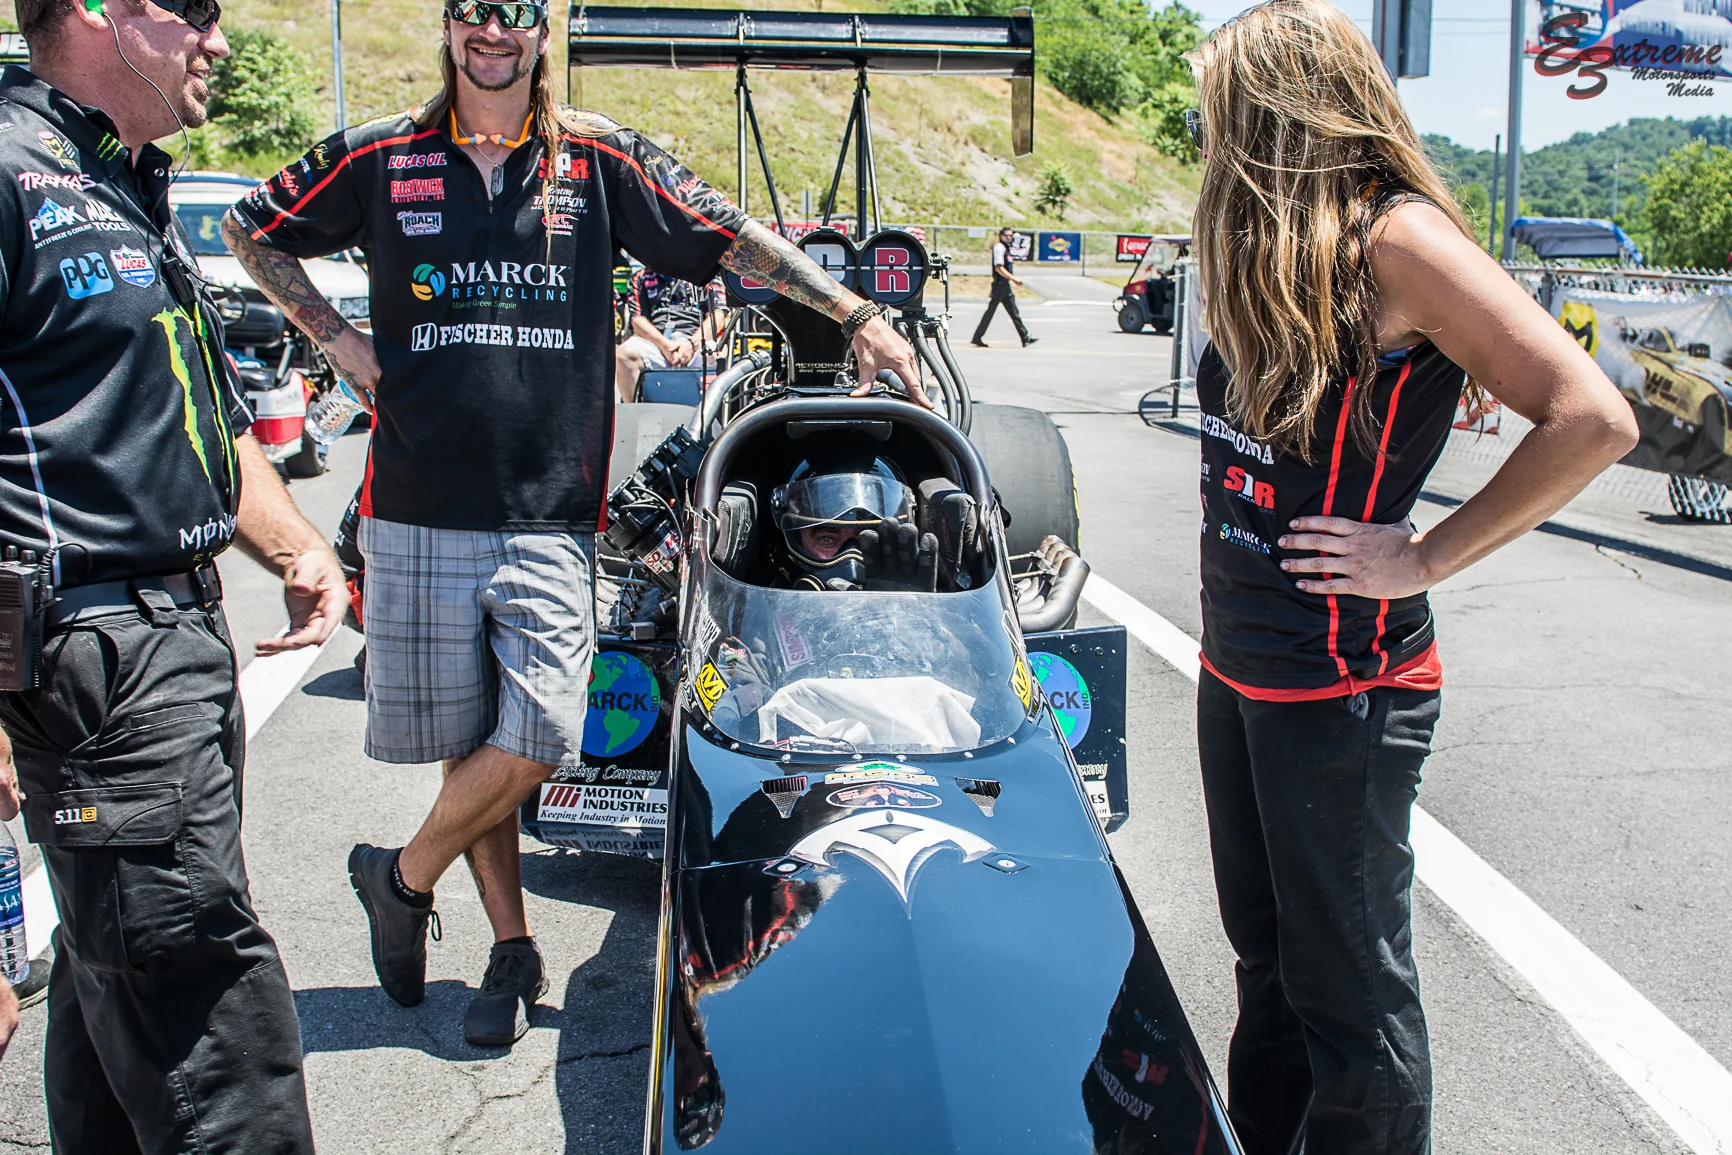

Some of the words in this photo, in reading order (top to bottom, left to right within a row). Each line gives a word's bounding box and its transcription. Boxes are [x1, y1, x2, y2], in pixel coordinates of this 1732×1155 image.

[388, 154, 426, 169] LUCAS
[427, 152, 447, 166] OIL
[391, 178, 444, 195] BOSTWICK
[29, 205, 88, 241] PEAK
[91, 221, 131, 232] TOOLS
[404, 214, 440, 229] ROACH
[121, 259, 147, 270] LUCAS
[62, 257, 109, 291] PPG
[450, 260, 567, 288] MARCK
[452, 285, 567, 302] RECYCLING
[439, 323, 513, 347] FISCHER
[517, 326, 575, 350] HONDA
[1231, 527, 1272, 554] MARCK
[588, 691, 648, 712] ARCK
[603, 765, 661, 786] Company
[584, 787, 645, 800] MOTION
[583, 799, 668, 813] INDUSTRIES
[55, 808, 82, 825] 5.11
[540, 809, 577, 821] Keeping
[580, 812, 618, 824] Industry
[620, 814, 630, 823] in
[634, 815, 666, 825] Motion
